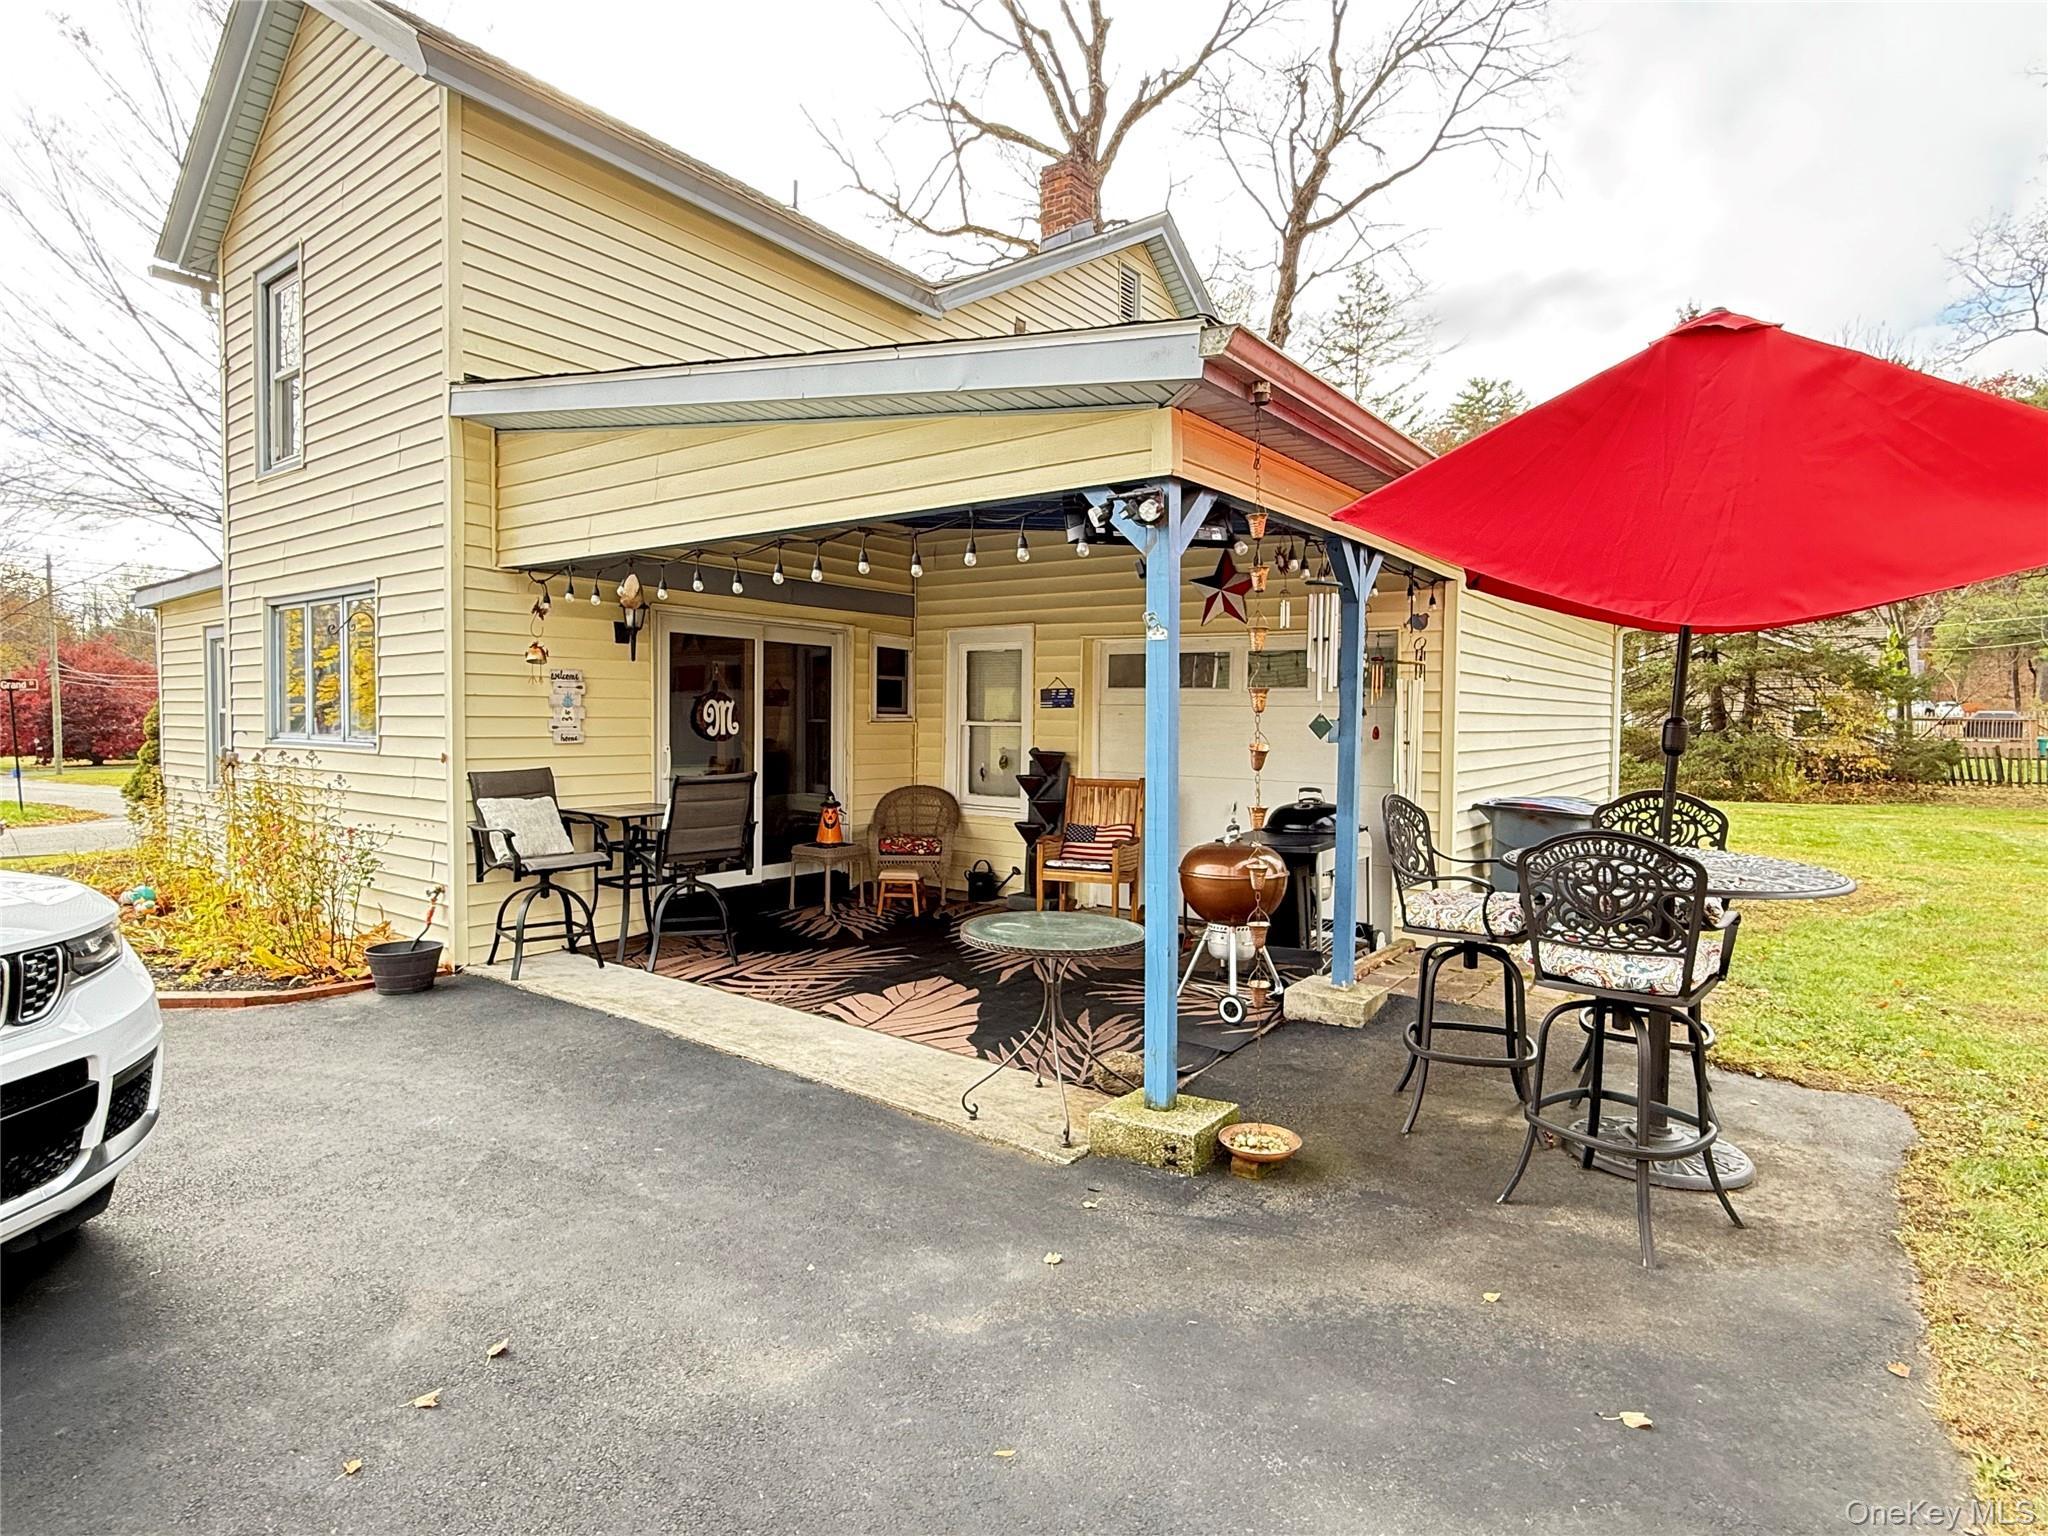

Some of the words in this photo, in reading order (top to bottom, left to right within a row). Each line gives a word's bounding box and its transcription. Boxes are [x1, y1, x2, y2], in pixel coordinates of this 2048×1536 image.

[551, 670, 580, 681] welcome
[0, 680, 27, 689] Grand
[703, 699, 740, 737] M
[560, 733, 578, 742] home
